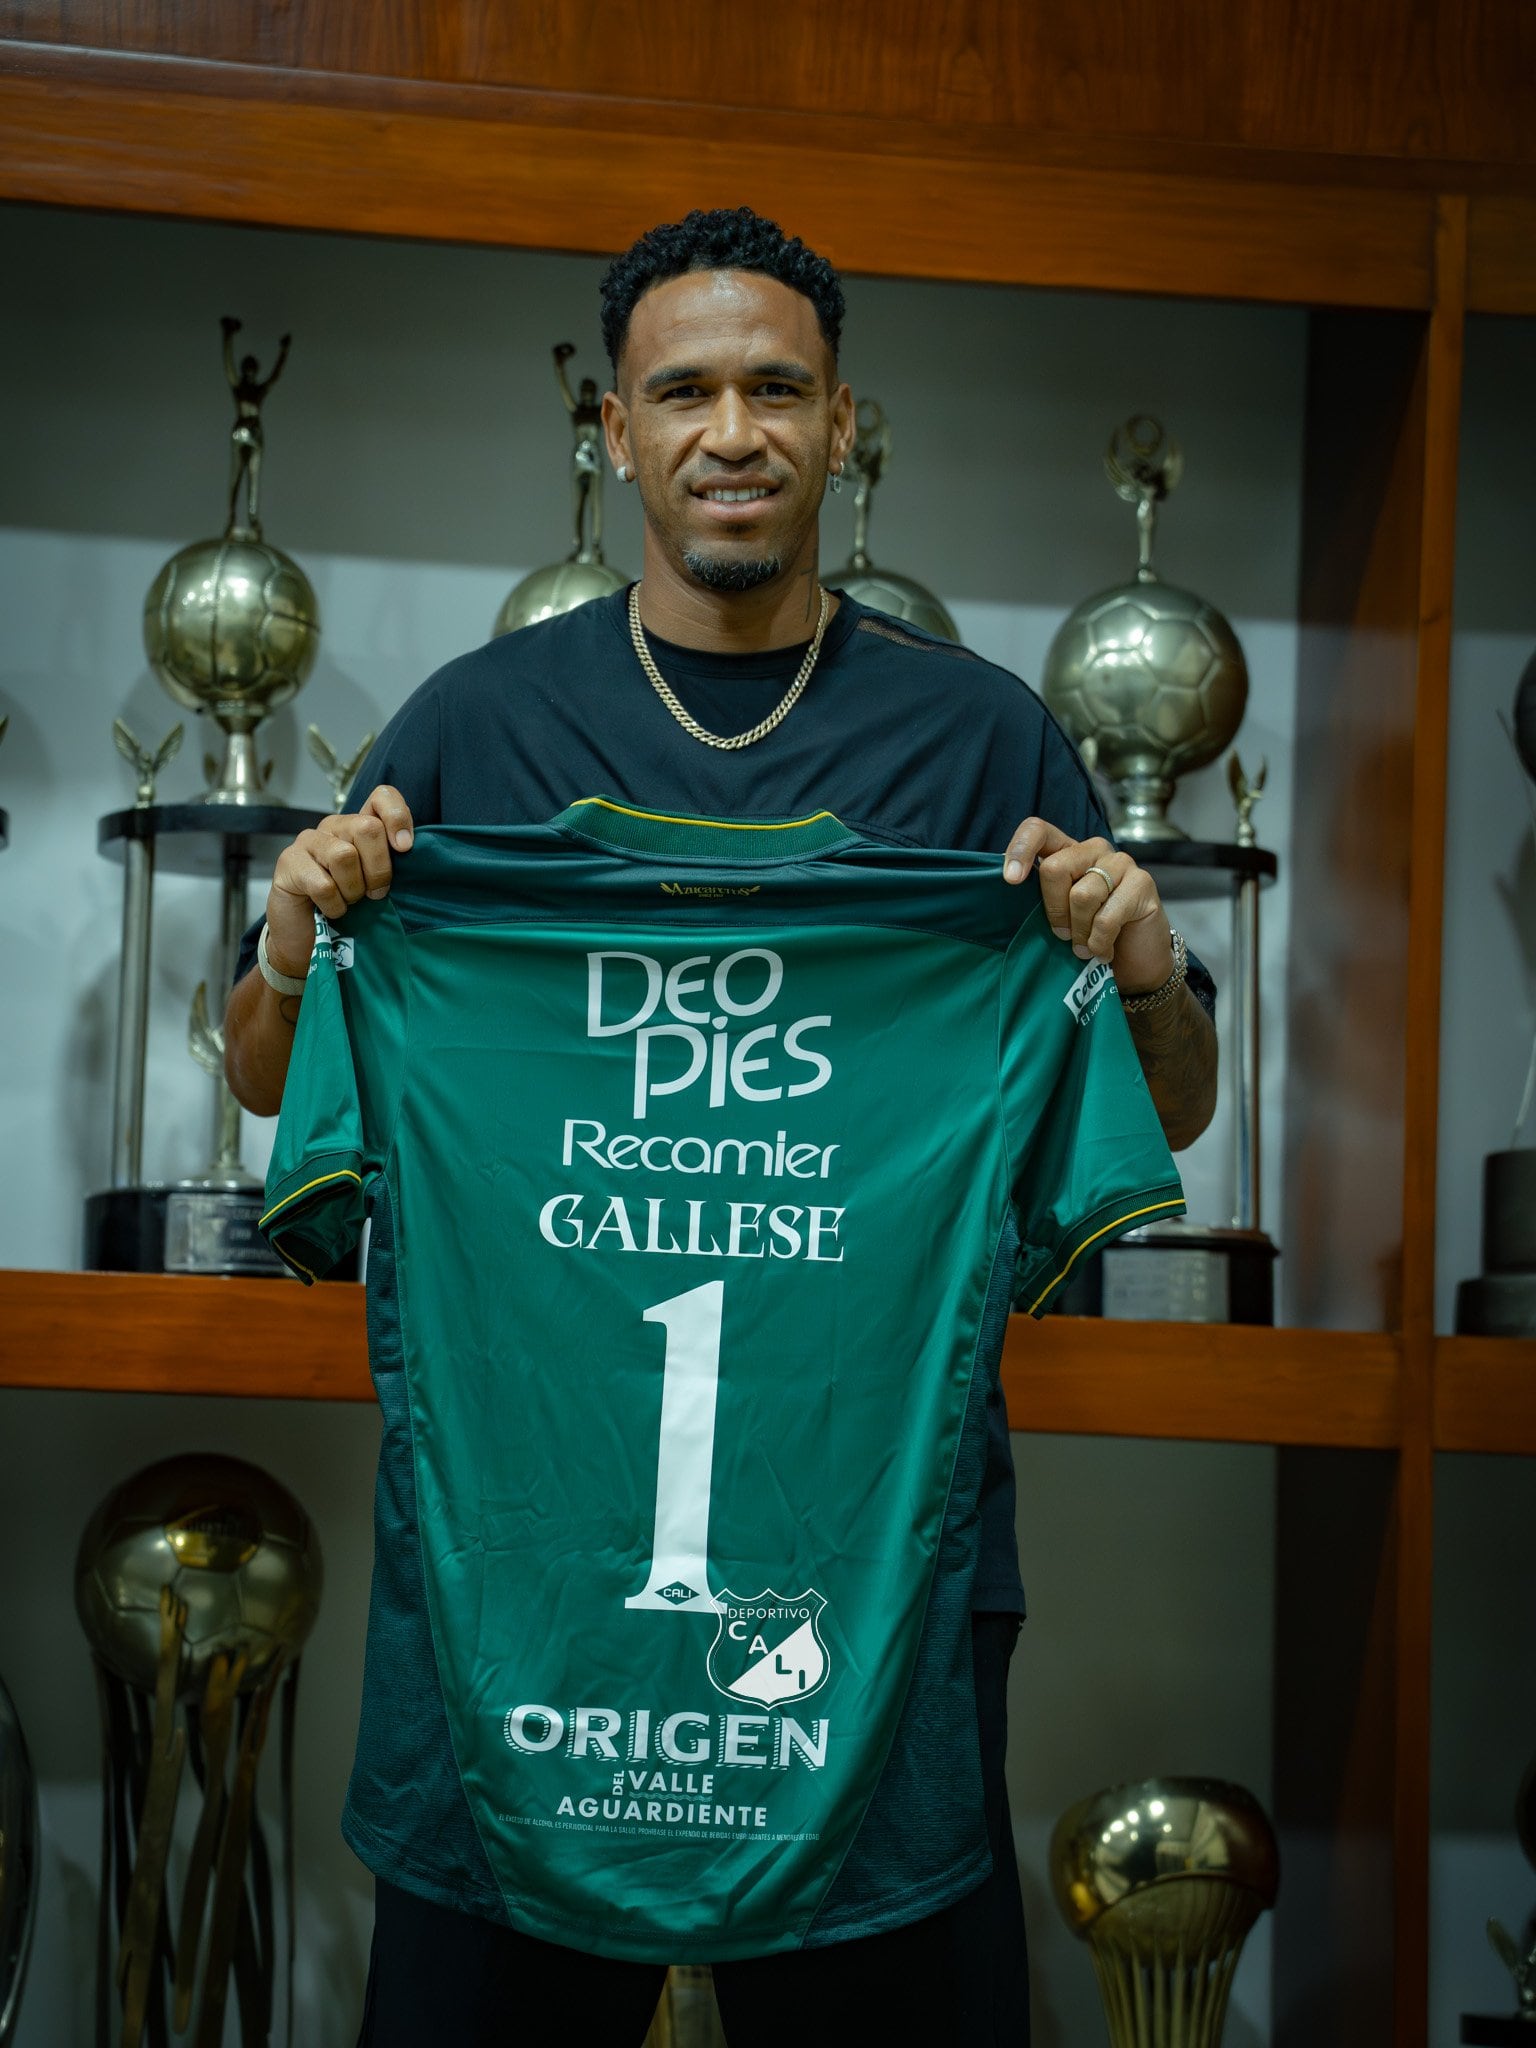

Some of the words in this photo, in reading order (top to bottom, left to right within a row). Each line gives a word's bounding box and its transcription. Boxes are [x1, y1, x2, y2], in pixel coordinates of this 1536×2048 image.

[587, 948, 784, 1038] DEO
[1080, 1012, 1090, 1026] El
[562, 1119, 841, 1179] Recamier
[538, 1194, 846, 1262] GALLESE
[624, 1280, 728, 1614] 1
[662, 1587, 692, 1600] CALI
[727, 1607, 811, 1620] DEPORTIVO
[728, 1620, 807, 1690] CALI
[503, 1704, 830, 1772] ORIGEN
[612, 1770, 625, 1796] DEL
[628, 1770, 714, 1794] VALLE
[556, 1796, 767, 1827] AGUARDIENTE
[595, 1825, 610, 1833] PARA
[610, 1825, 618, 1833] LA
[667, 1829, 673, 1837] EL
